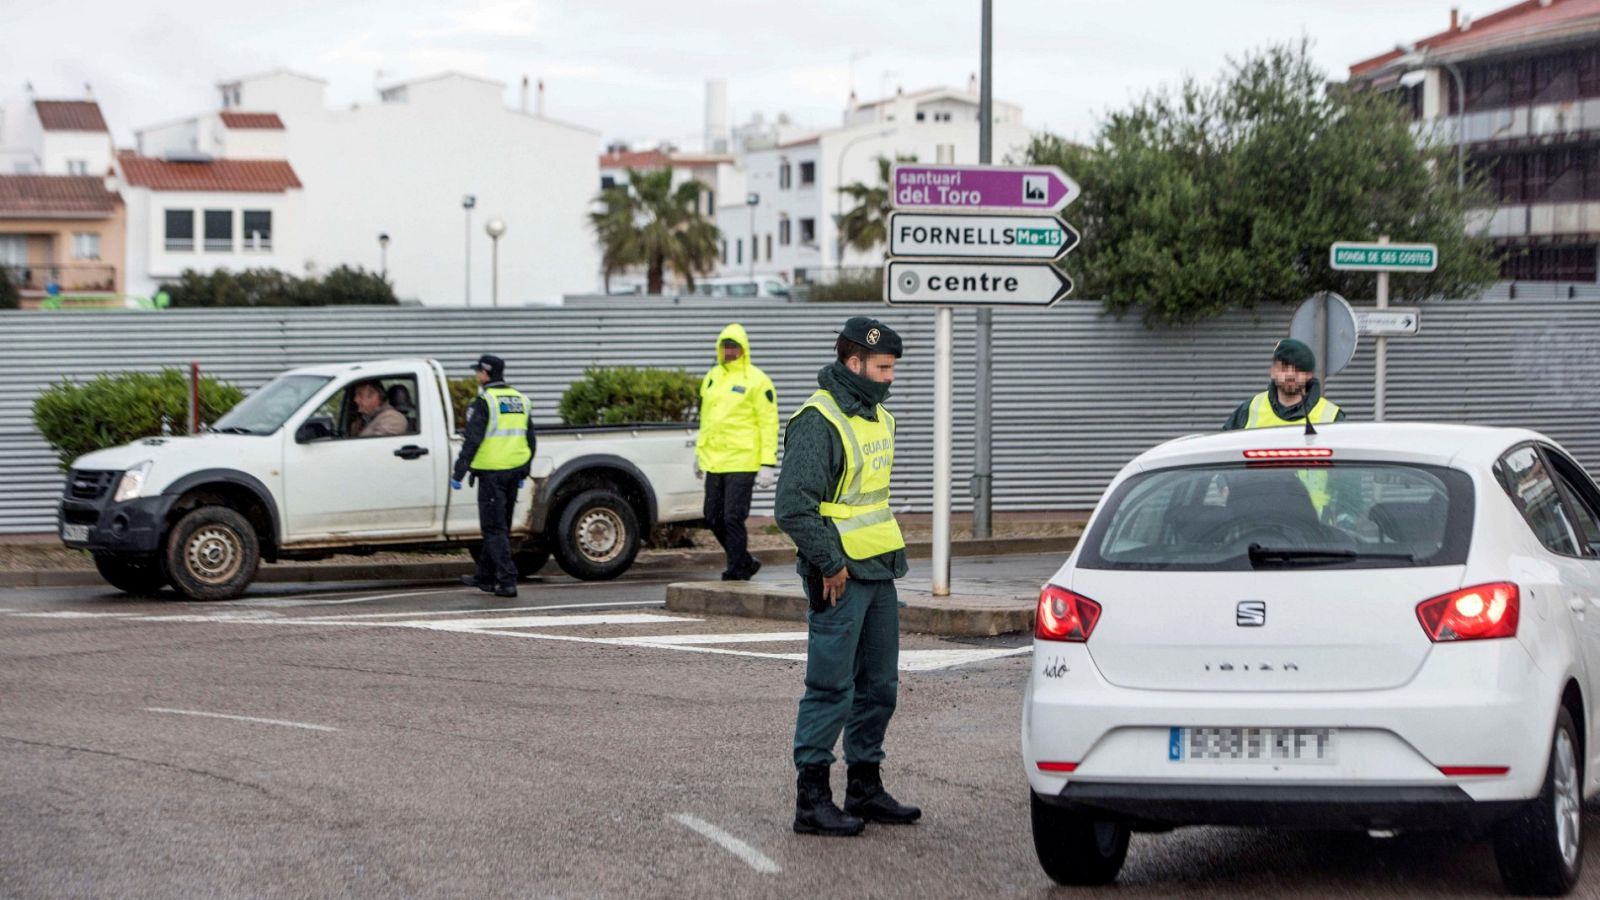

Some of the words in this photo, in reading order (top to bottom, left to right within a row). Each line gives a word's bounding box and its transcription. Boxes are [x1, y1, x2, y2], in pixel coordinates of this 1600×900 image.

[899, 171, 961, 185] santuari
[899, 186, 930, 204] del
[937, 187, 982, 205] Toro
[900, 226, 1015, 245] FORNELLS
[1017, 230, 1060, 245] Me-15
[1337, 251, 1366, 263] RONDA
[1367, 251, 1379, 263] DE
[1380, 251, 1397, 264] SES
[1398, 251, 1431, 265] COSTES
[927, 272, 1019, 292] centre
